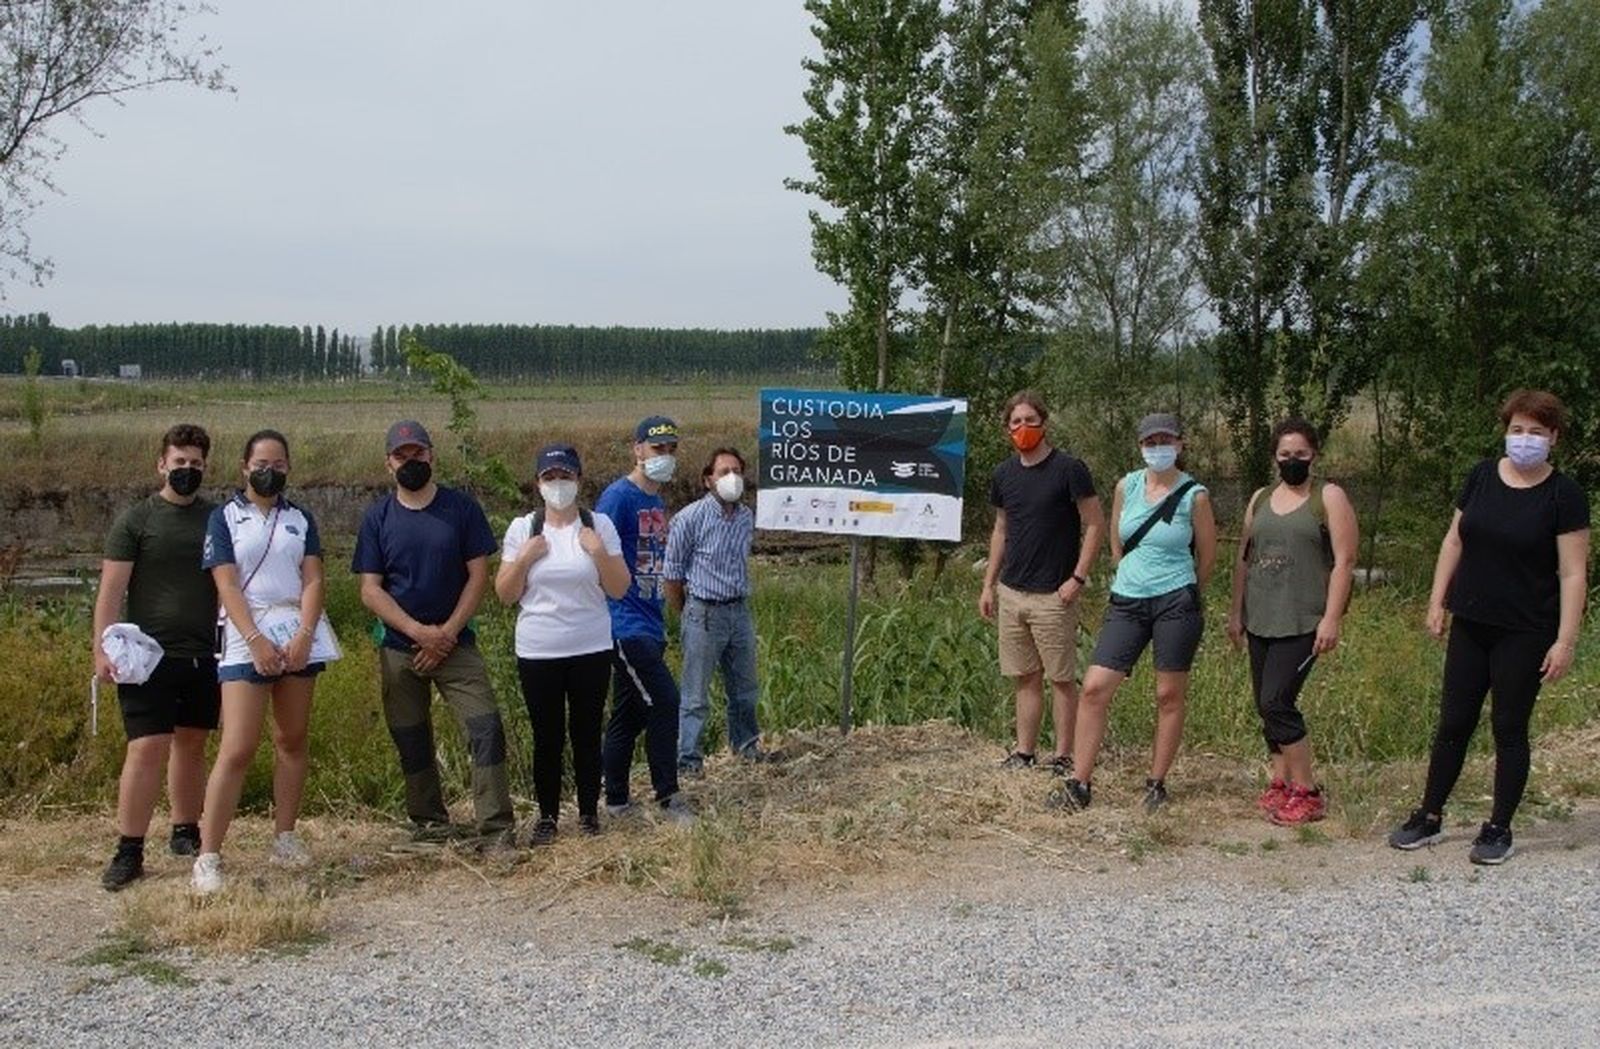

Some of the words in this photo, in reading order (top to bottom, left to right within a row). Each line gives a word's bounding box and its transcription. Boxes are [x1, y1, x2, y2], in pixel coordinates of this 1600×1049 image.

[772, 399, 885, 420] CUSTODIA
[772, 420, 812, 439] LOS
[771, 439, 820, 461] RÍOS
[828, 445, 856, 463] DE
[770, 464, 878, 487] GRANADA
